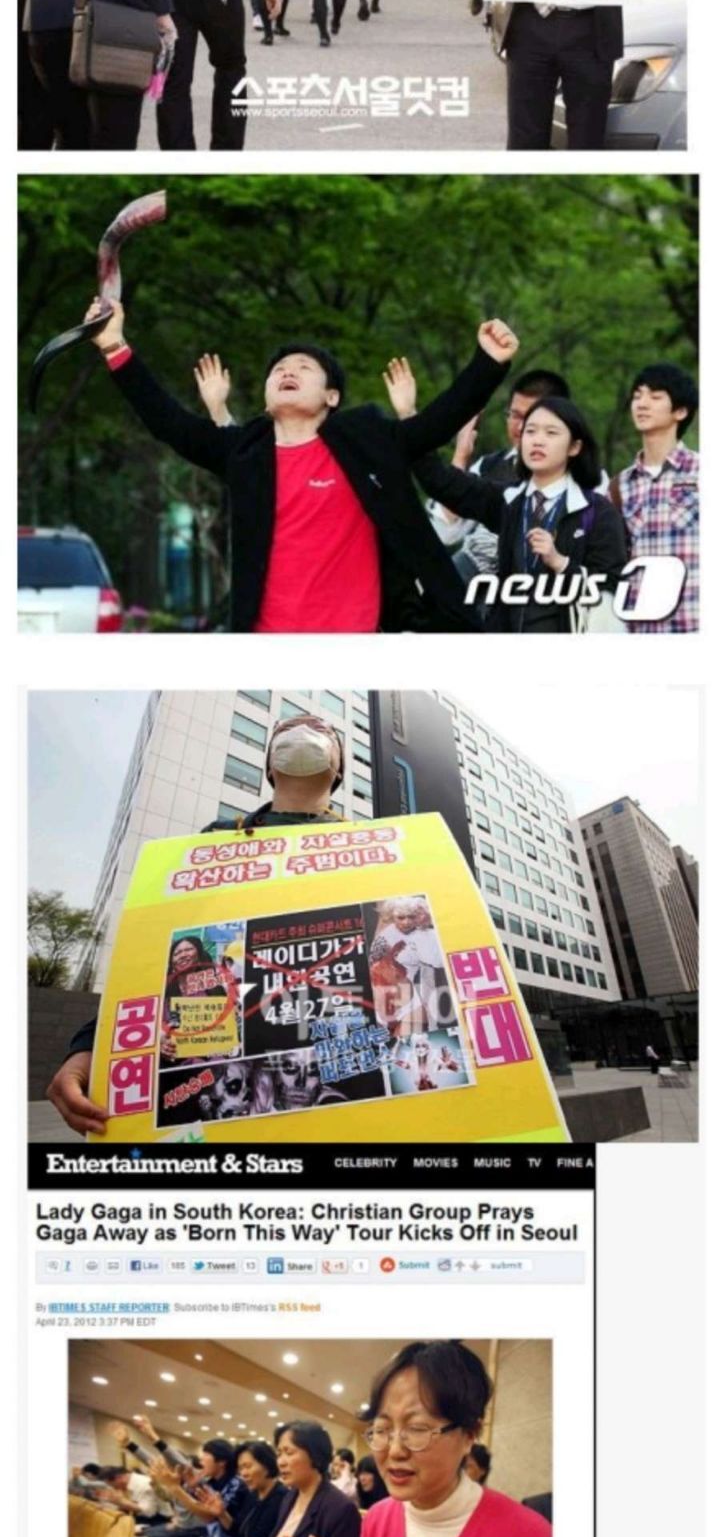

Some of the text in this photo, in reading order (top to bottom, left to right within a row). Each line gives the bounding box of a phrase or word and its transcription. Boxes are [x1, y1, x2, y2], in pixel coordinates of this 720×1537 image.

[191, 837, 287, 864] 동성애와
[171, 861, 273, 891] 확산하는
[253, 934, 364, 969] 레이디가가
[112, 997, 156, 1114] 공연
[46, 1151, 303, 1173] Entertainment & Stars
[335, 1157, 397, 1168] CELEBRITY
[413, 1157, 458, 1168] MOVIES
[474, 1157, 511, 1168] MUSIC
[527, 1157, 541, 1168] TV
[557, 1157, 582, 1168] FINE
[36, 1203, 534, 1223] Lady Gaga in South Korea: Christian Group Prays
[36, 1224, 578, 1244] Gaga Away as 'Born This Way' Tour Kicks Off in Seoul
[143, 1260, 159, 1270] Like
[207, 1261, 236, 1270] Tweet
[287, 1262, 313, 1272] Share
[399, 1260, 430, 1270] Submit
[490, 1261, 522, 1270] submit
[36, 1303, 47, 1315] By
[89, 1303, 117, 1313] STAFF
[118, 1303, 169, 1313] REPORTER
[174, 1303, 219, 1312] Subscribe
[221, 1303, 229, 1312] to
[278, 1303, 297, 1312] RSS
[299, 1303, 320, 1312] feed
[36, 1318, 56, 1329] April
[74, 1318, 97, 1327] 2012
[120, 1318, 135, 1327] PM
[136, 1318, 156, 1327] EDT
